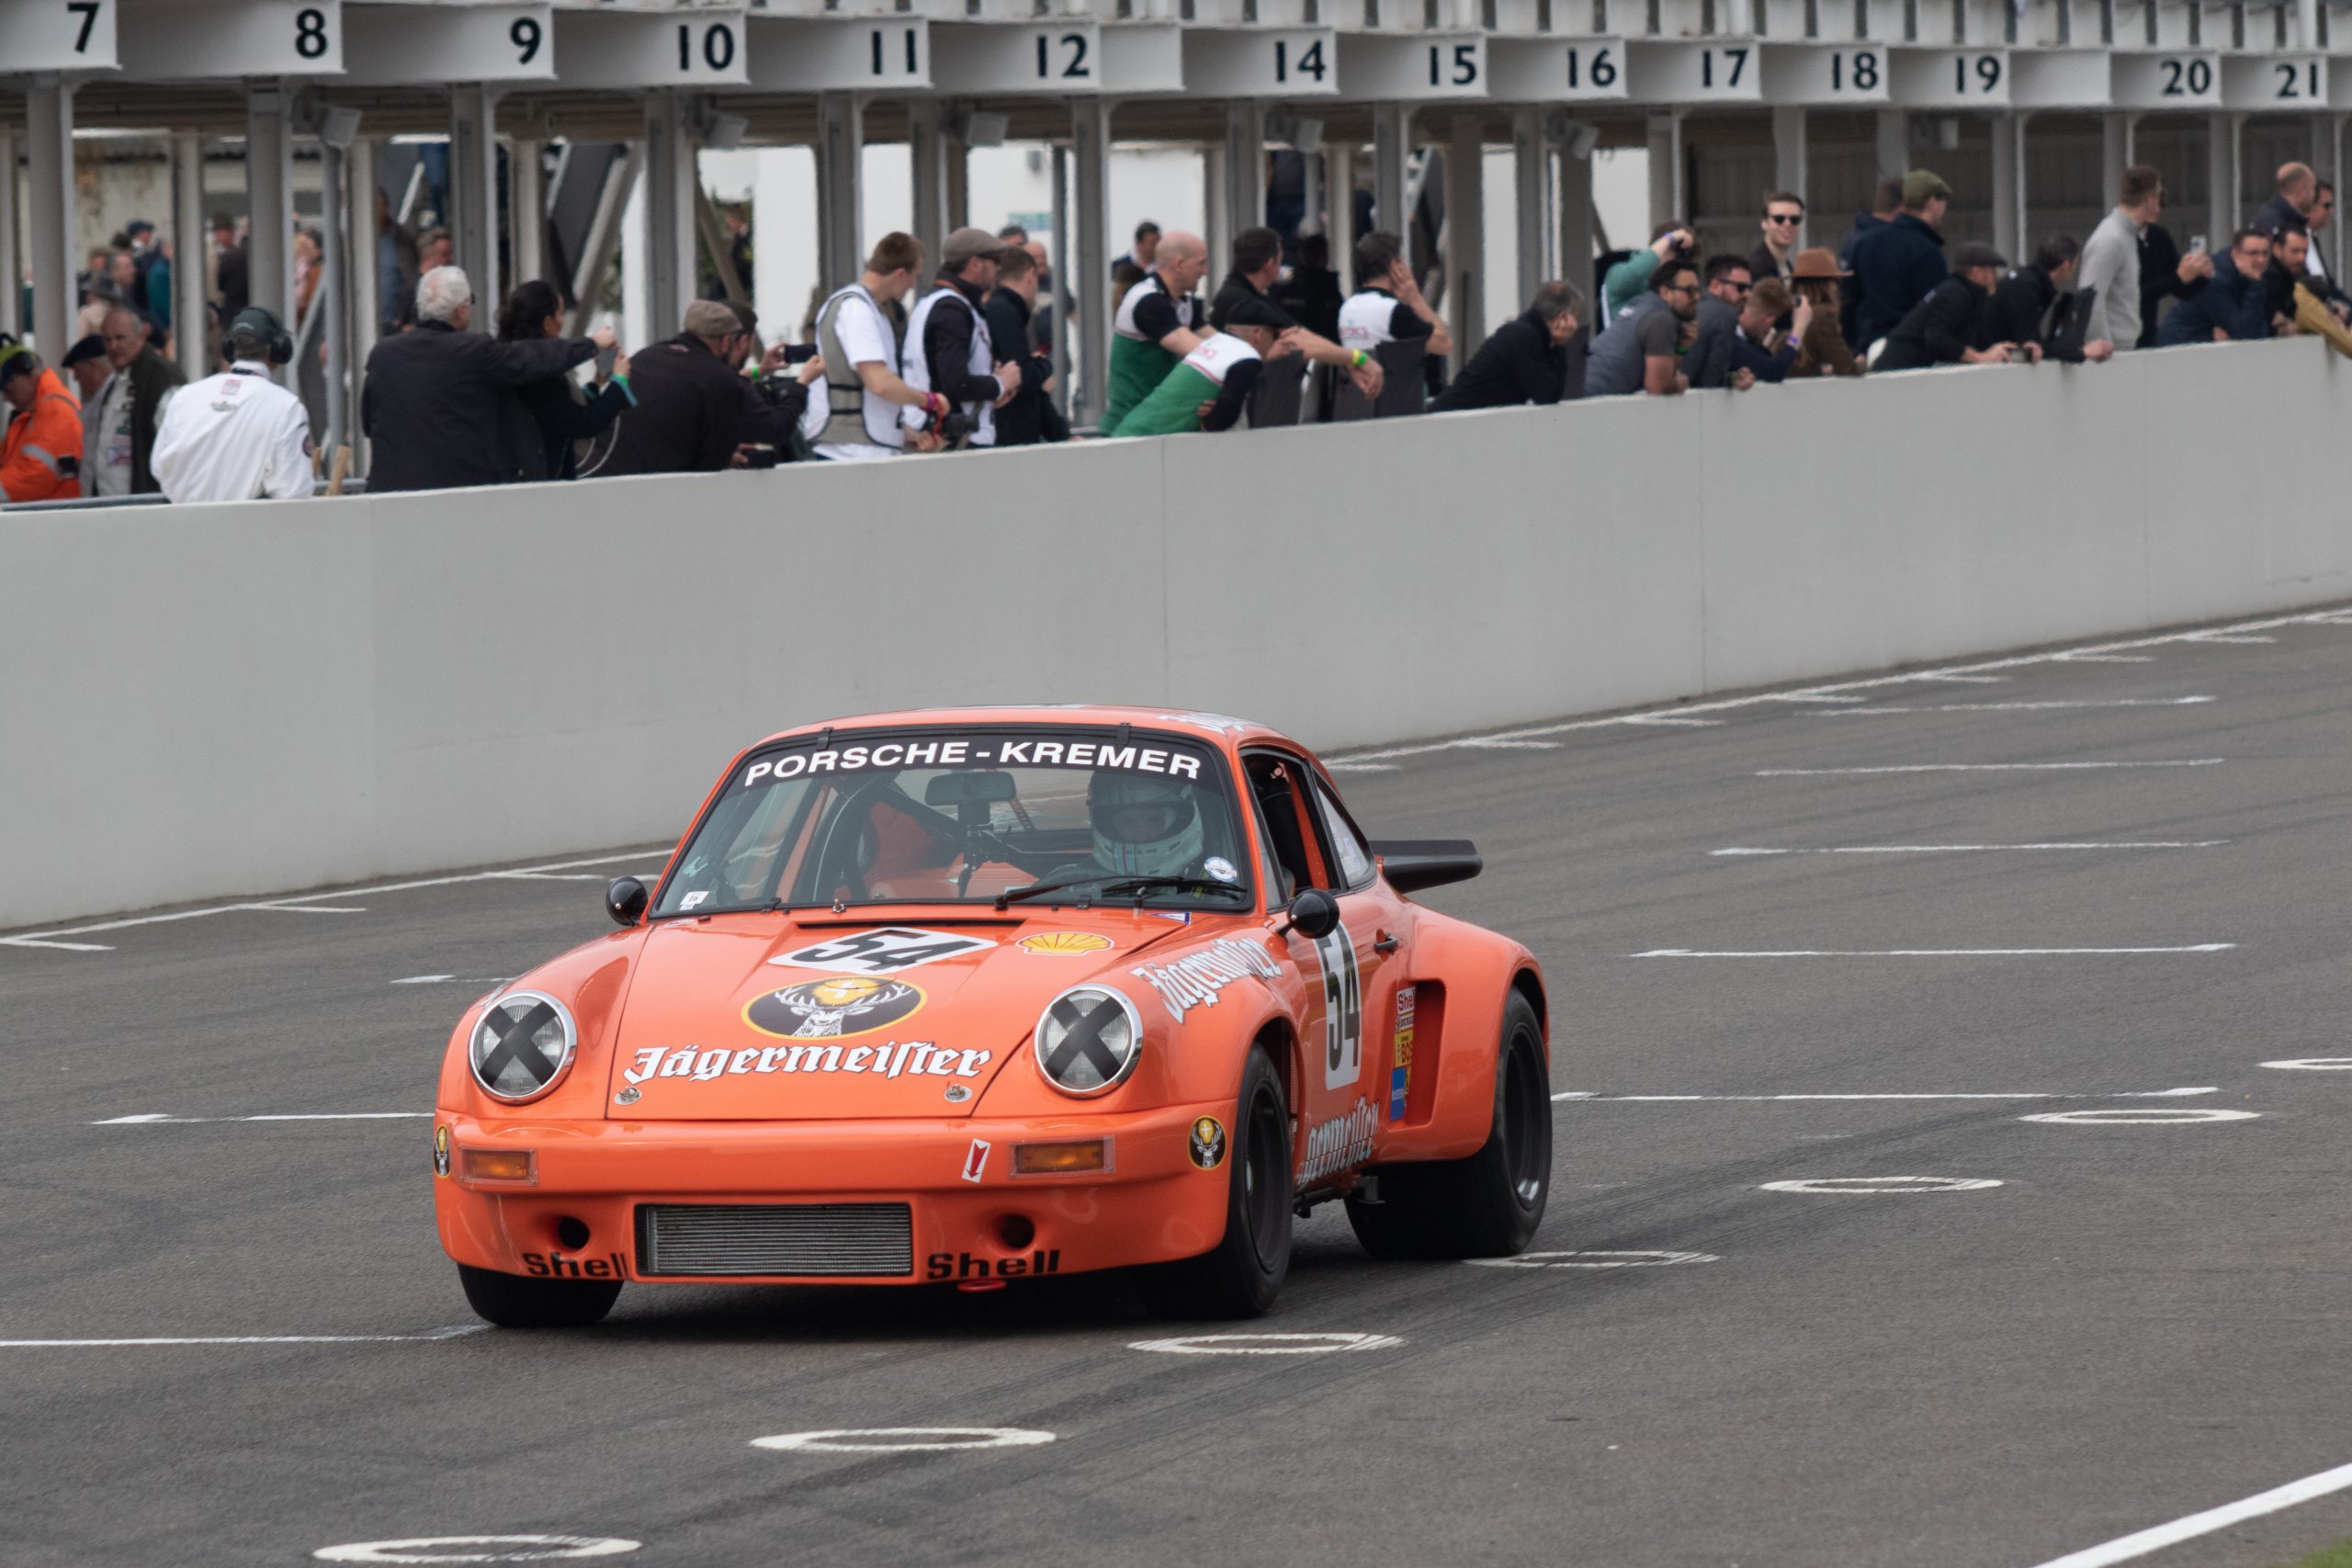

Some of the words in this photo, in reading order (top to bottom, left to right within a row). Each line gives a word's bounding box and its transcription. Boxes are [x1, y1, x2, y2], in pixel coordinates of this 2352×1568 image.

[67, 1, 100, 53] 7
[295, 8, 327, 59] 8
[510, 17, 541, 64] 9
[678, 23, 734, 71] 10
[871, 28, 916, 75] 11
[1036, 33, 1089, 77] 12
[1275, 39, 1326, 83] 14
[1430, 45, 1476, 85] 15
[1567, 48, 1616, 88] 16
[1702, 48, 1748, 87] 17
[1832, 51, 1878, 90] 18
[1956, 54, 2001, 93] 19
[2161, 59, 2211, 95] 20
[2276, 63, 2317, 98] 21
[791, 929, 983, 972] 54
[1316, 924, 1360, 1071] 54
[522, 1252, 629, 1278] Shell
[926, 1249, 1061, 1280] Shell
